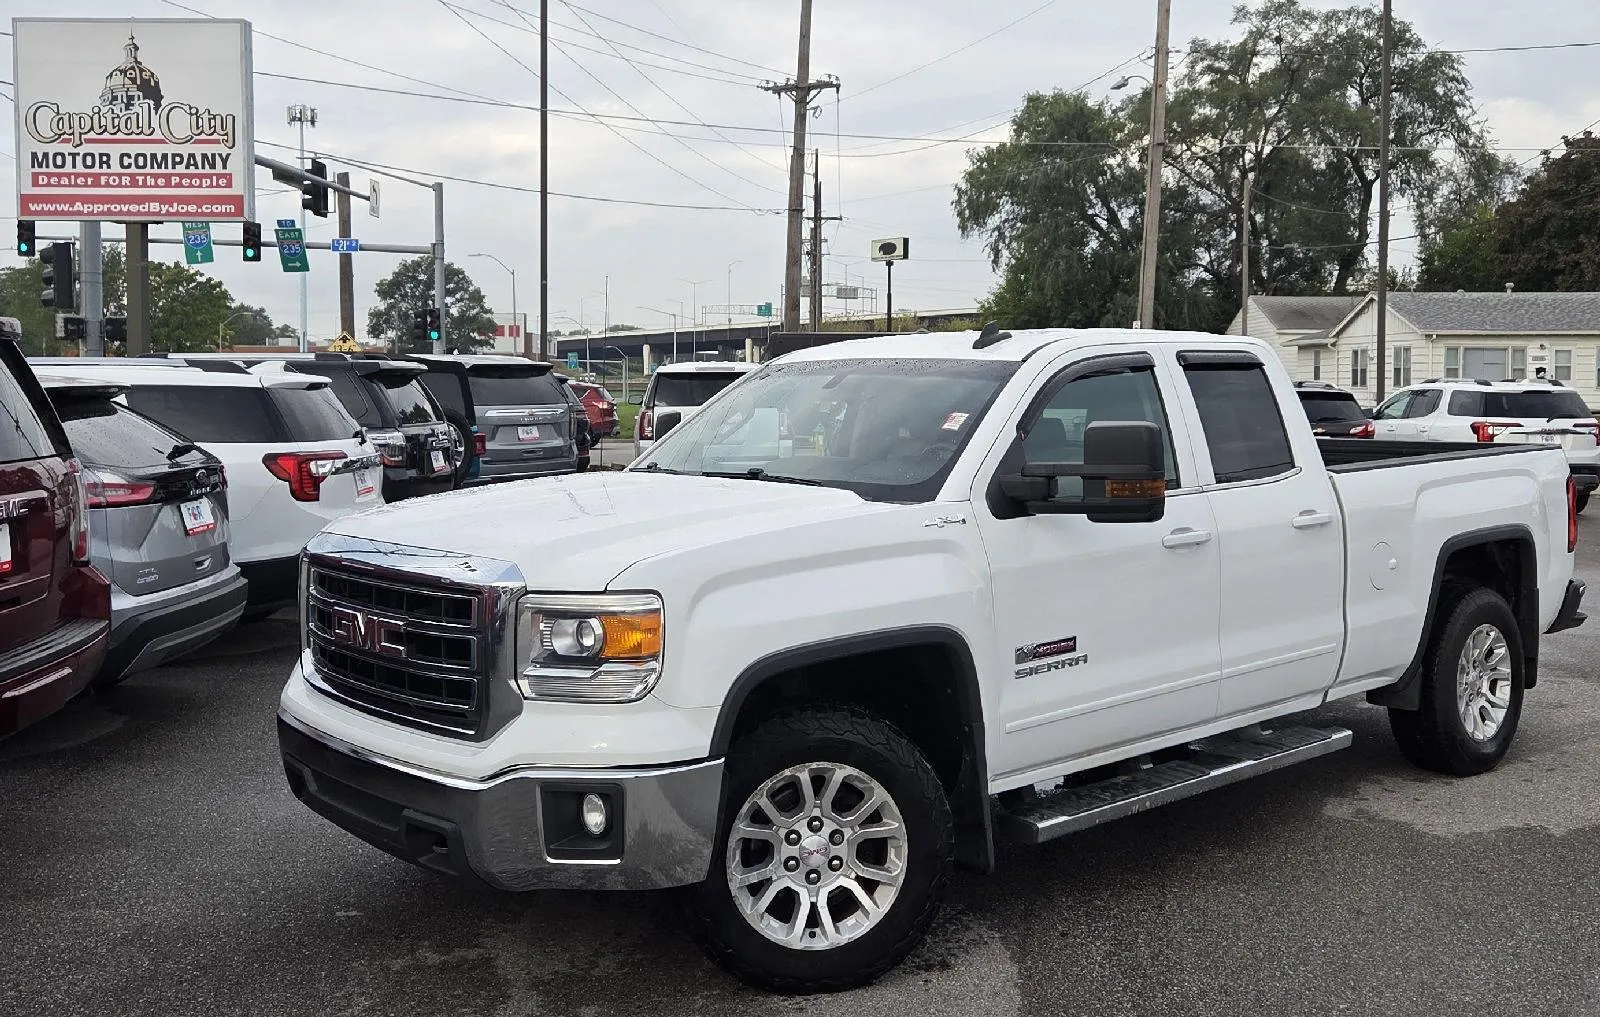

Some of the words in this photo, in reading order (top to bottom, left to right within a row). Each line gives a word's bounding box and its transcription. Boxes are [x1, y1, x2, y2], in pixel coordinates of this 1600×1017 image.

[25, 101, 154, 148] Capital
[159, 102, 236, 149] City
[30, 151, 112, 170] MOTOR
[119, 152, 231, 170] COMPANY
[38, 175, 94, 185] Dealer
[100, 175, 130, 186] FOR
[136, 176, 166, 187] The
[171, 176, 227, 188] People
[29, 202, 235, 214] www.ApprovedByJoe.com
[188, 235, 207, 244] 235
[279, 231, 300, 239] EAST
[283, 244, 302, 254] 235
[331, 605, 407, 659] GMC
[1014, 653, 1089, 680] SIERRA
